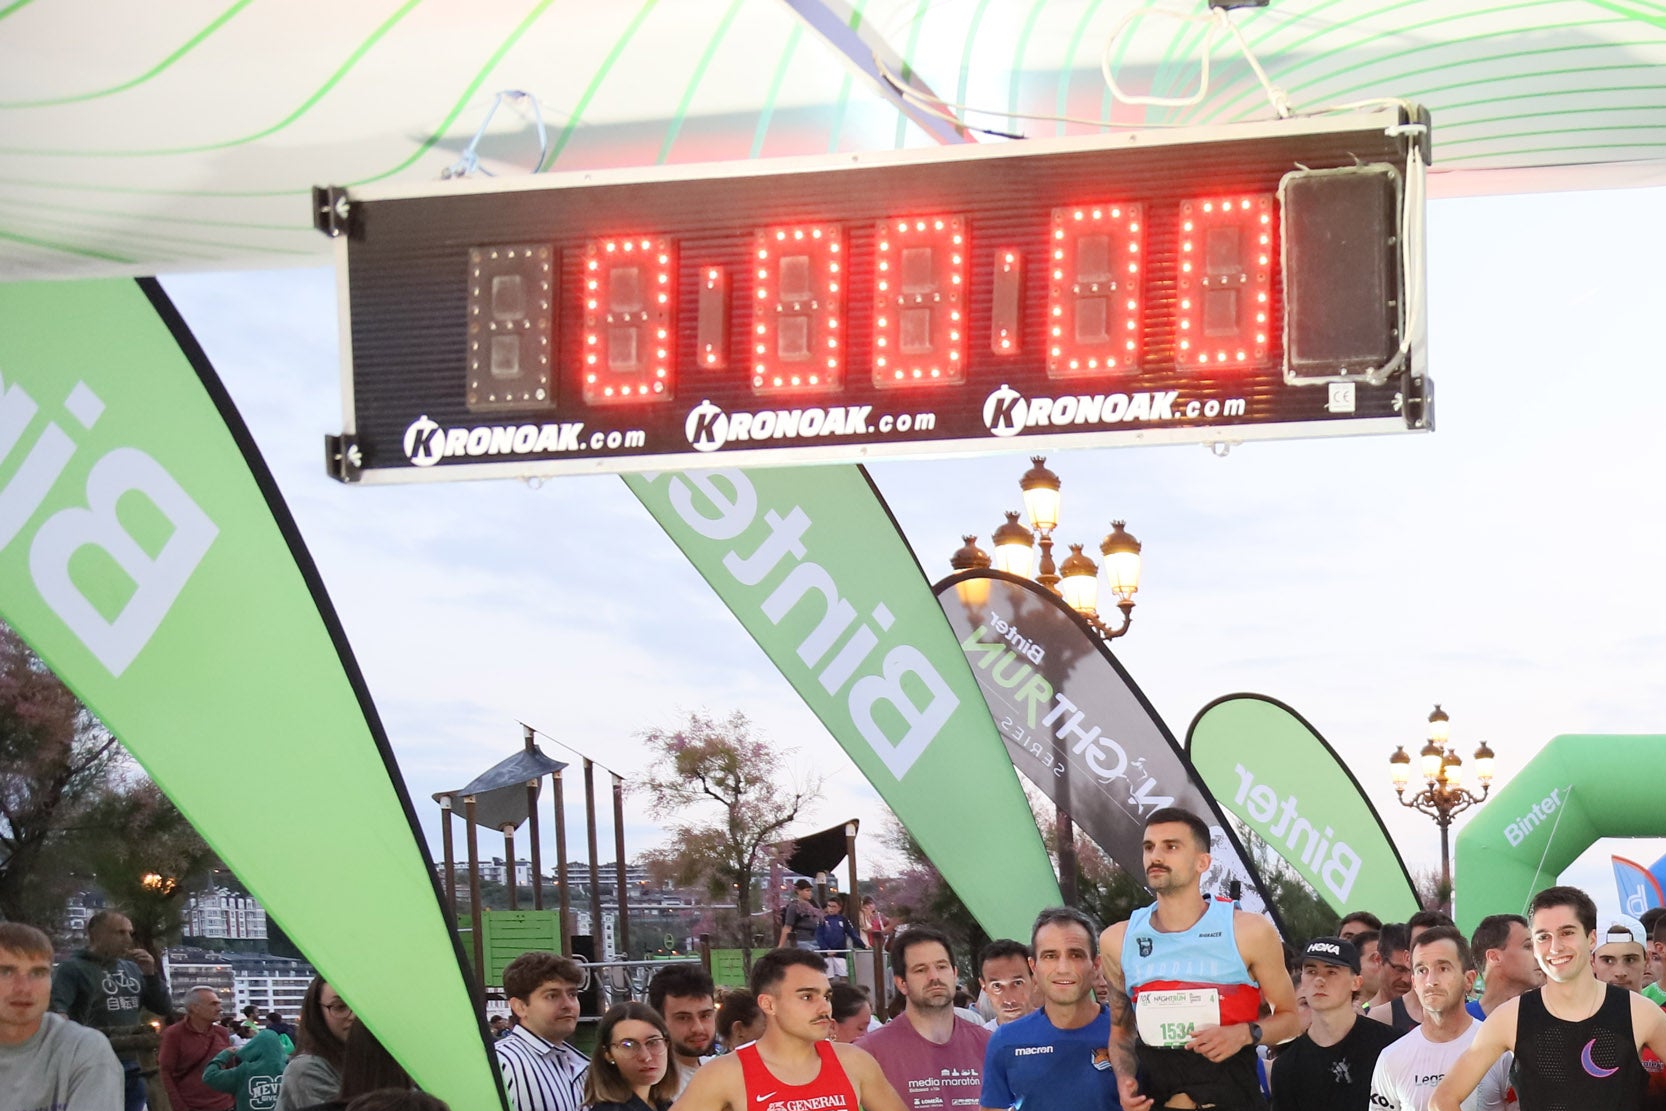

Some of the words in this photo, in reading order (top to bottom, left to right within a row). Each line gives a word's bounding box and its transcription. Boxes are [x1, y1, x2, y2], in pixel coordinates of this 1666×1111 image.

[983, 384, 1246, 437] KRONOAK.com
[684, 400, 936, 452] KRONOAK.com
[404, 415, 645, 467] KRONOAK.com
[1502, 787, 1564, 848] Binter
[1307, 943, 1340, 955] HOKA
[1160, 1022, 1195, 1040] 1534
[1014, 1045, 1054, 1057] macron
[908, 1077, 940, 1088] media
[941, 1076, 981, 1086] maratón
[787, 1095, 847, 1111] GENERALI
